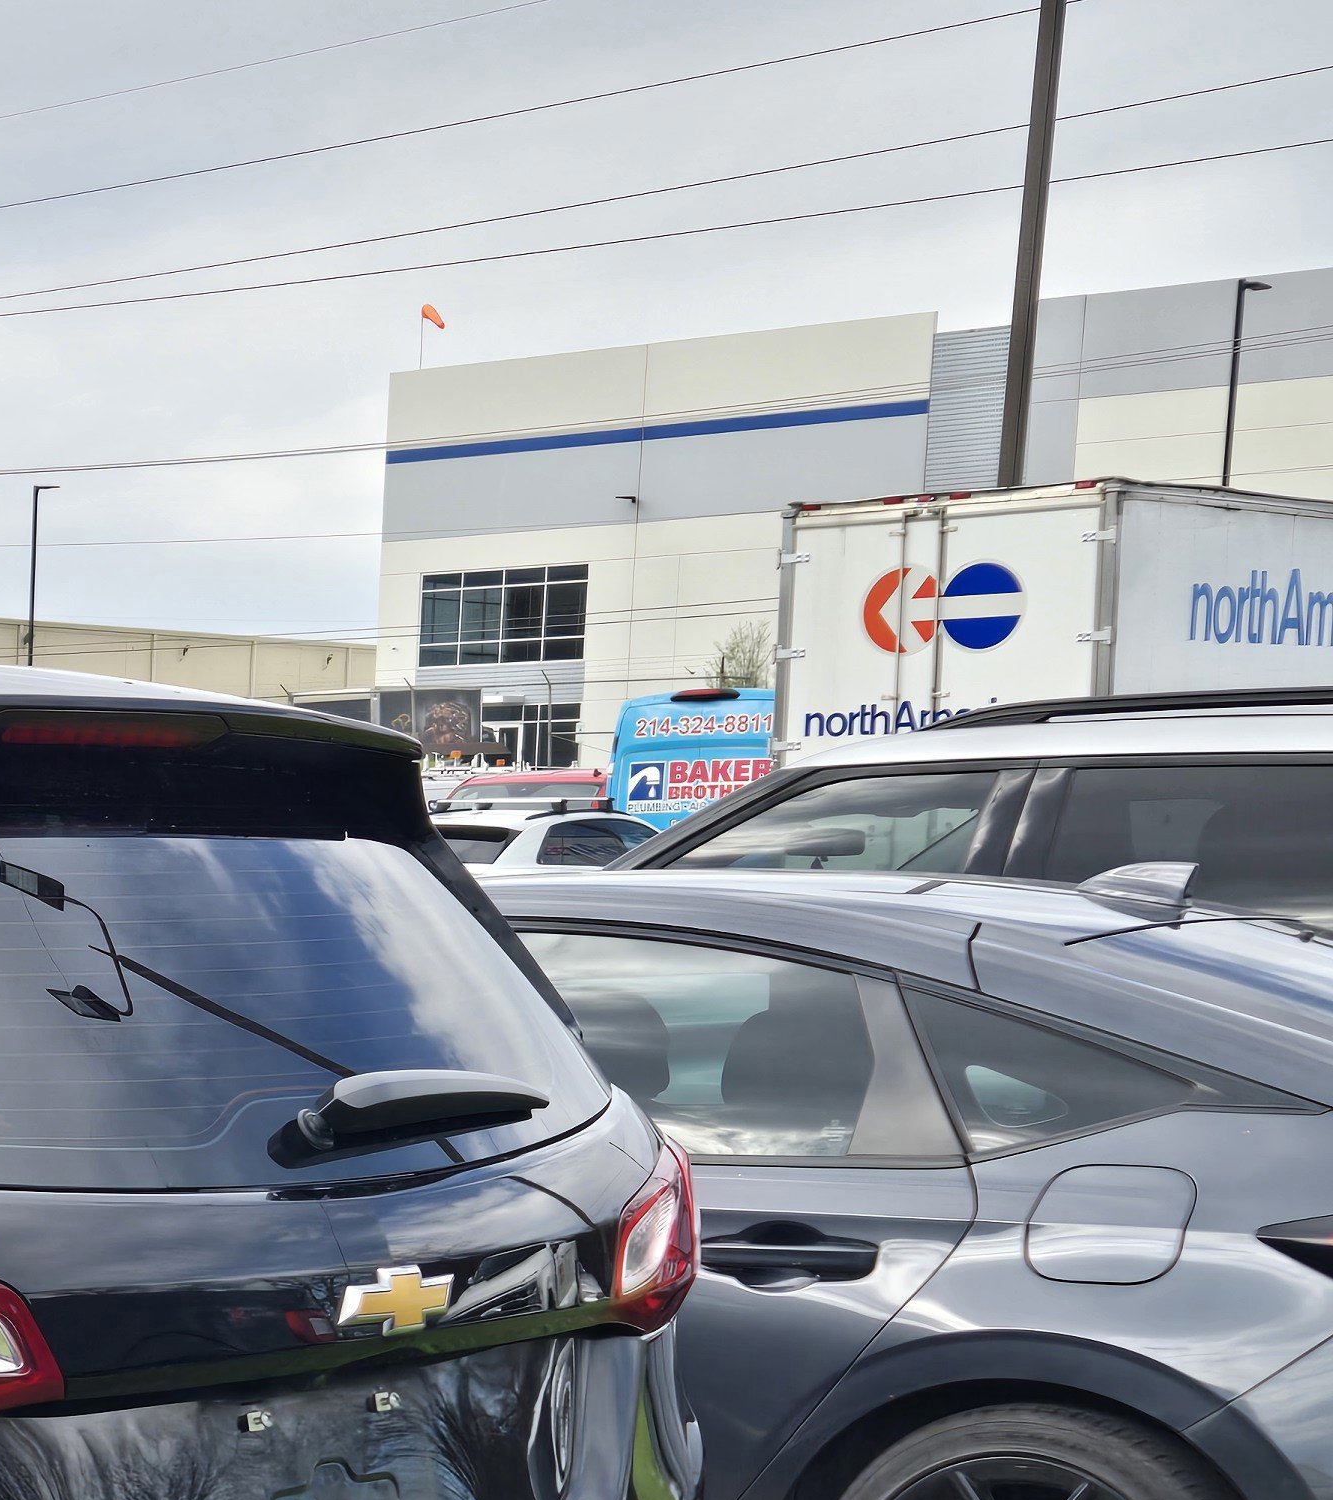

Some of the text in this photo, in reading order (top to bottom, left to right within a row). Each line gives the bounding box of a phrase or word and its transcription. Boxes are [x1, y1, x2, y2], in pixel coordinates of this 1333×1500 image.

[636, 714, 773, 736] 214-324-8811
[668, 760, 773, 783] BAKER
[627, 802, 680, 813] PLUMBING
